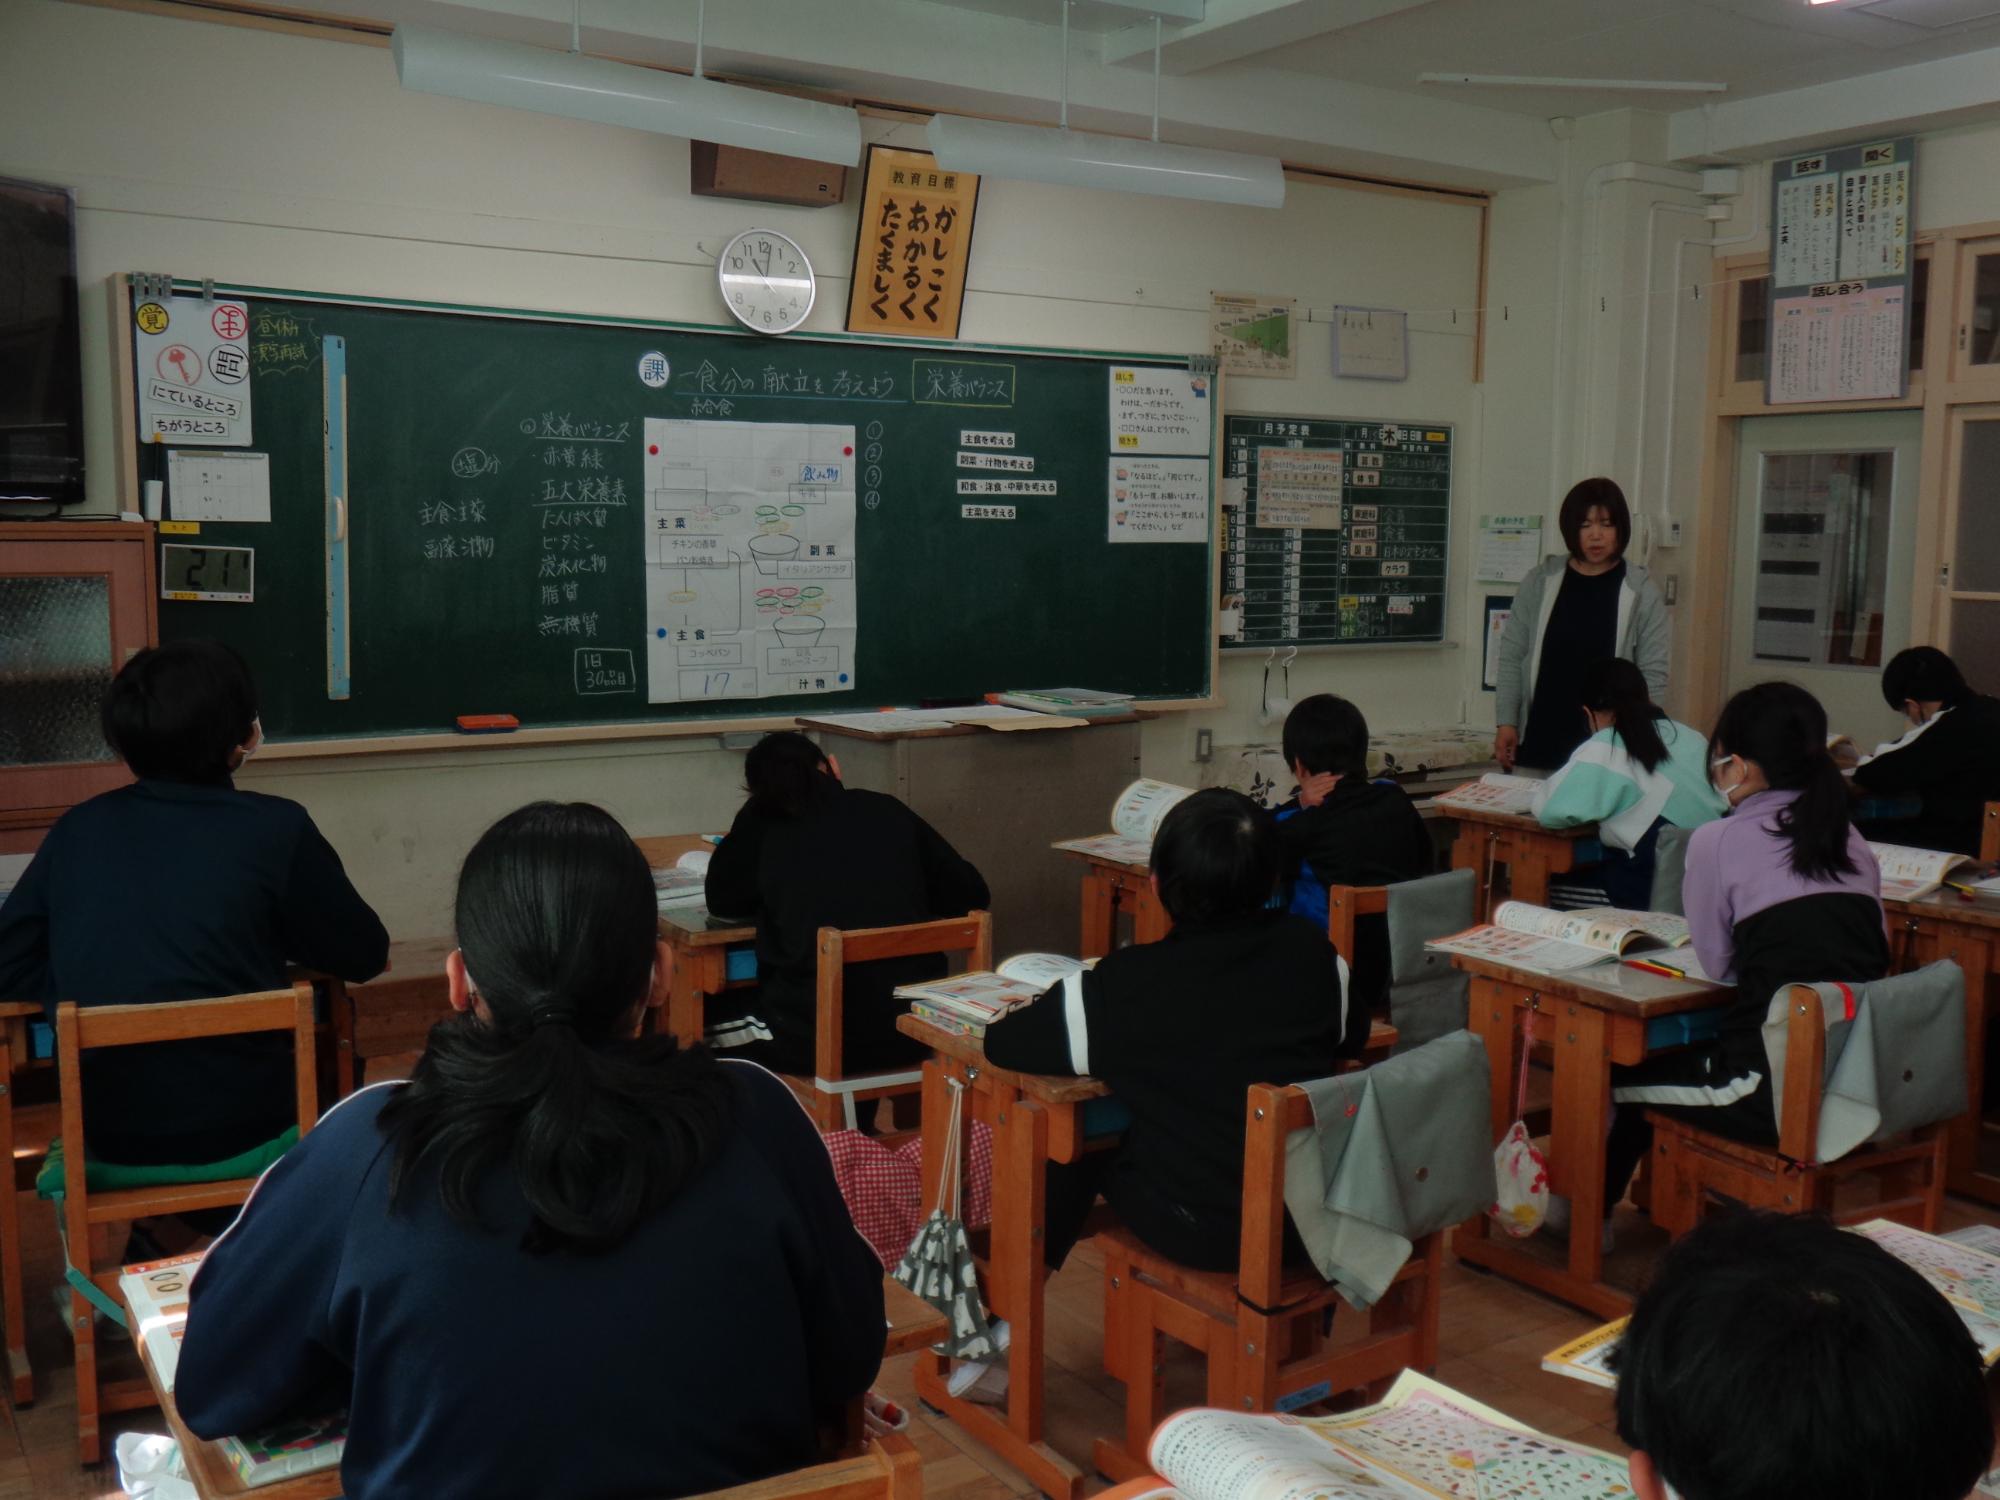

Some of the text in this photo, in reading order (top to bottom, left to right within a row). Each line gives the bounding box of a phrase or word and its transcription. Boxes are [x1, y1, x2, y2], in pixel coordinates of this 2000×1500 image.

[1865, 148, 1891, 163] 聞く
[1797, 160, 1821, 173] 話す
[893, 171, 957, 190] 教育目標
[744, 244, 752, 256] 11
[759, 241, 770, 254] 12
[733, 257, 744, 269] 10
[788, 261, 797, 273] 2
[870, 198, 902, 320] たくましく
[899, 200, 930, 321] あかるく
[923, 205, 957, 323] かしこく
[1812, 283, 1864, 297] 話し合う
[736, 293, 743, 304] 8
[790, 298, 798, 308] 4
[142, 306, 164, 330] 覚
[748, 305, 756, 317] 7
[764, 312, 772, 323] 6
[780, 308, 787, 320] 5
[215, 350, 243, 379] 問
[644, 358, 665, 382] 課
[678, 359, 896, 398] 一食分の献立を考えよう
[925, 368, 1010, 400] 栄養バランス
[153, 385, 236, 416] にているところ
[690, 399, 735, 416] 給食
[156, 419, 226, 434] ちがうところ
[541, 412, 631, 439] 栄養バランス
[1264, 422, 1310, 437] 月予定表
[965, 434, 1014, 446] 主食を考える
[1383, 427, 1395, 444] 木
[454, 451, 501, 475] 塩分
[960, 455, 1034, 470] 副菜・汁物を考える
[803, 465, 839, 482] 飲み物
[541, 476, 627, 505] 五大栄養素
[960, 479, 1056, 492] 和食・洋食・中華を考える
[966, 506, 1016, 518] 主菜を考える
[657, 517, 688, 530] 主菜
[543, 533, 595, 551] ビタミン
[809, 544, 837, 556] 副菜
[538, 553, 607, 577] 炭水化物
[541, 581, 580, 605] 脂質
[538, 611, 599, 637] 無機質
[676, 629, 705, 641] 主食
[585, 670, 626, 688] 30品目
[703, 671, 730, 697] 17
[799, 678, 826, 690] 汁物
